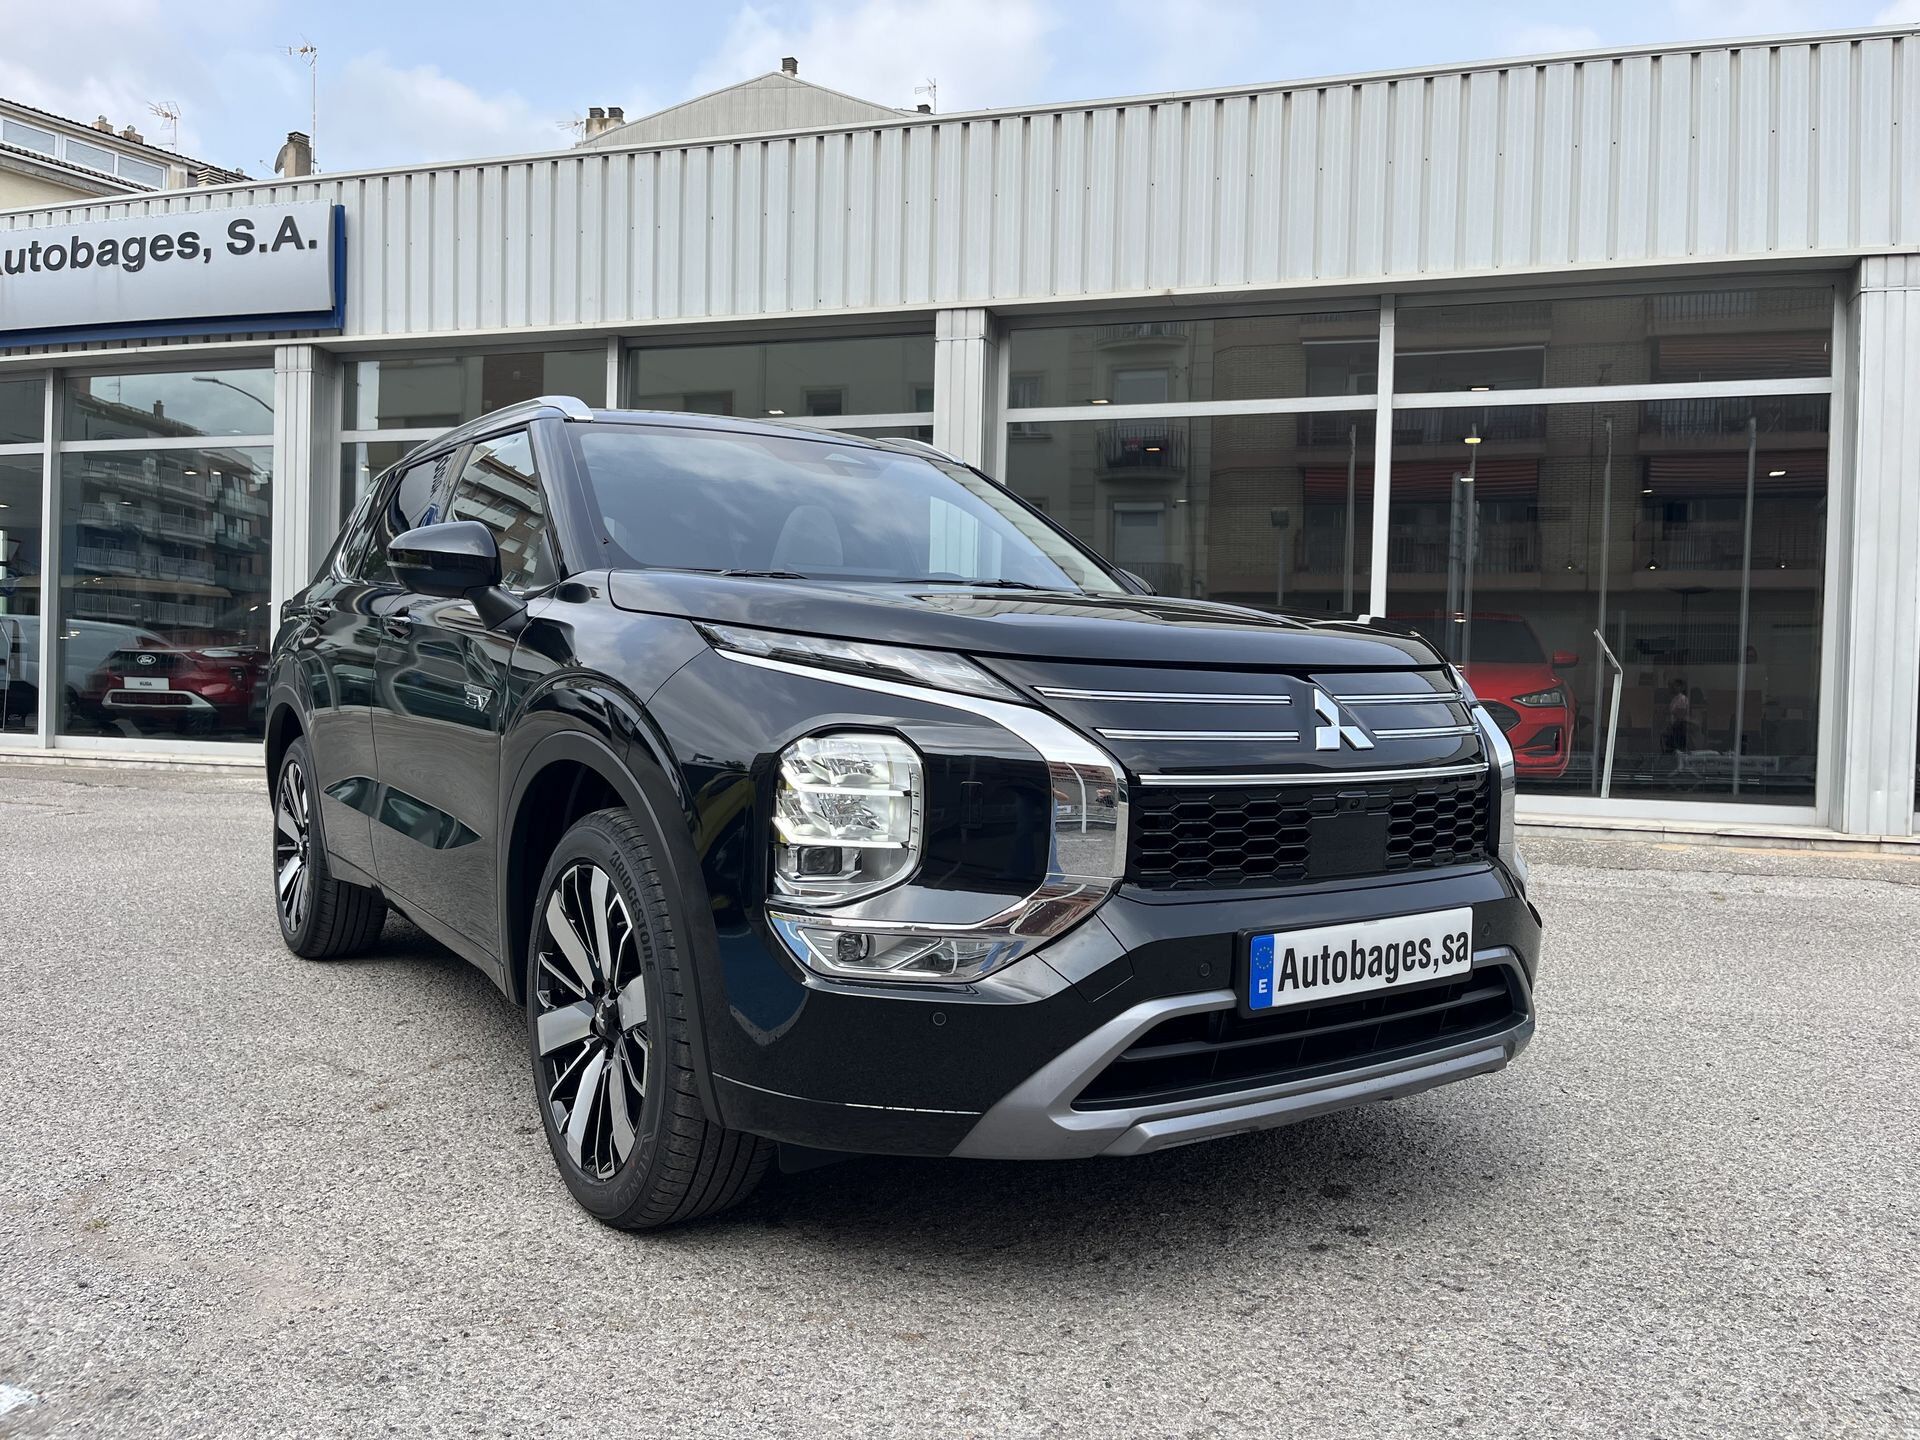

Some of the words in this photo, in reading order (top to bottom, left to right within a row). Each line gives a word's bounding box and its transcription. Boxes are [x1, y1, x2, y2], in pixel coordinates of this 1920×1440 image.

[0, 231, 212, 276] utobages,
[226, 215, 318, 255] S.A.
[609, 850, 656, 972] BRIDGESTONE
[1258, 978, 1268, 994] E
[1277, 931, 1469, 992] Autobages,sa
